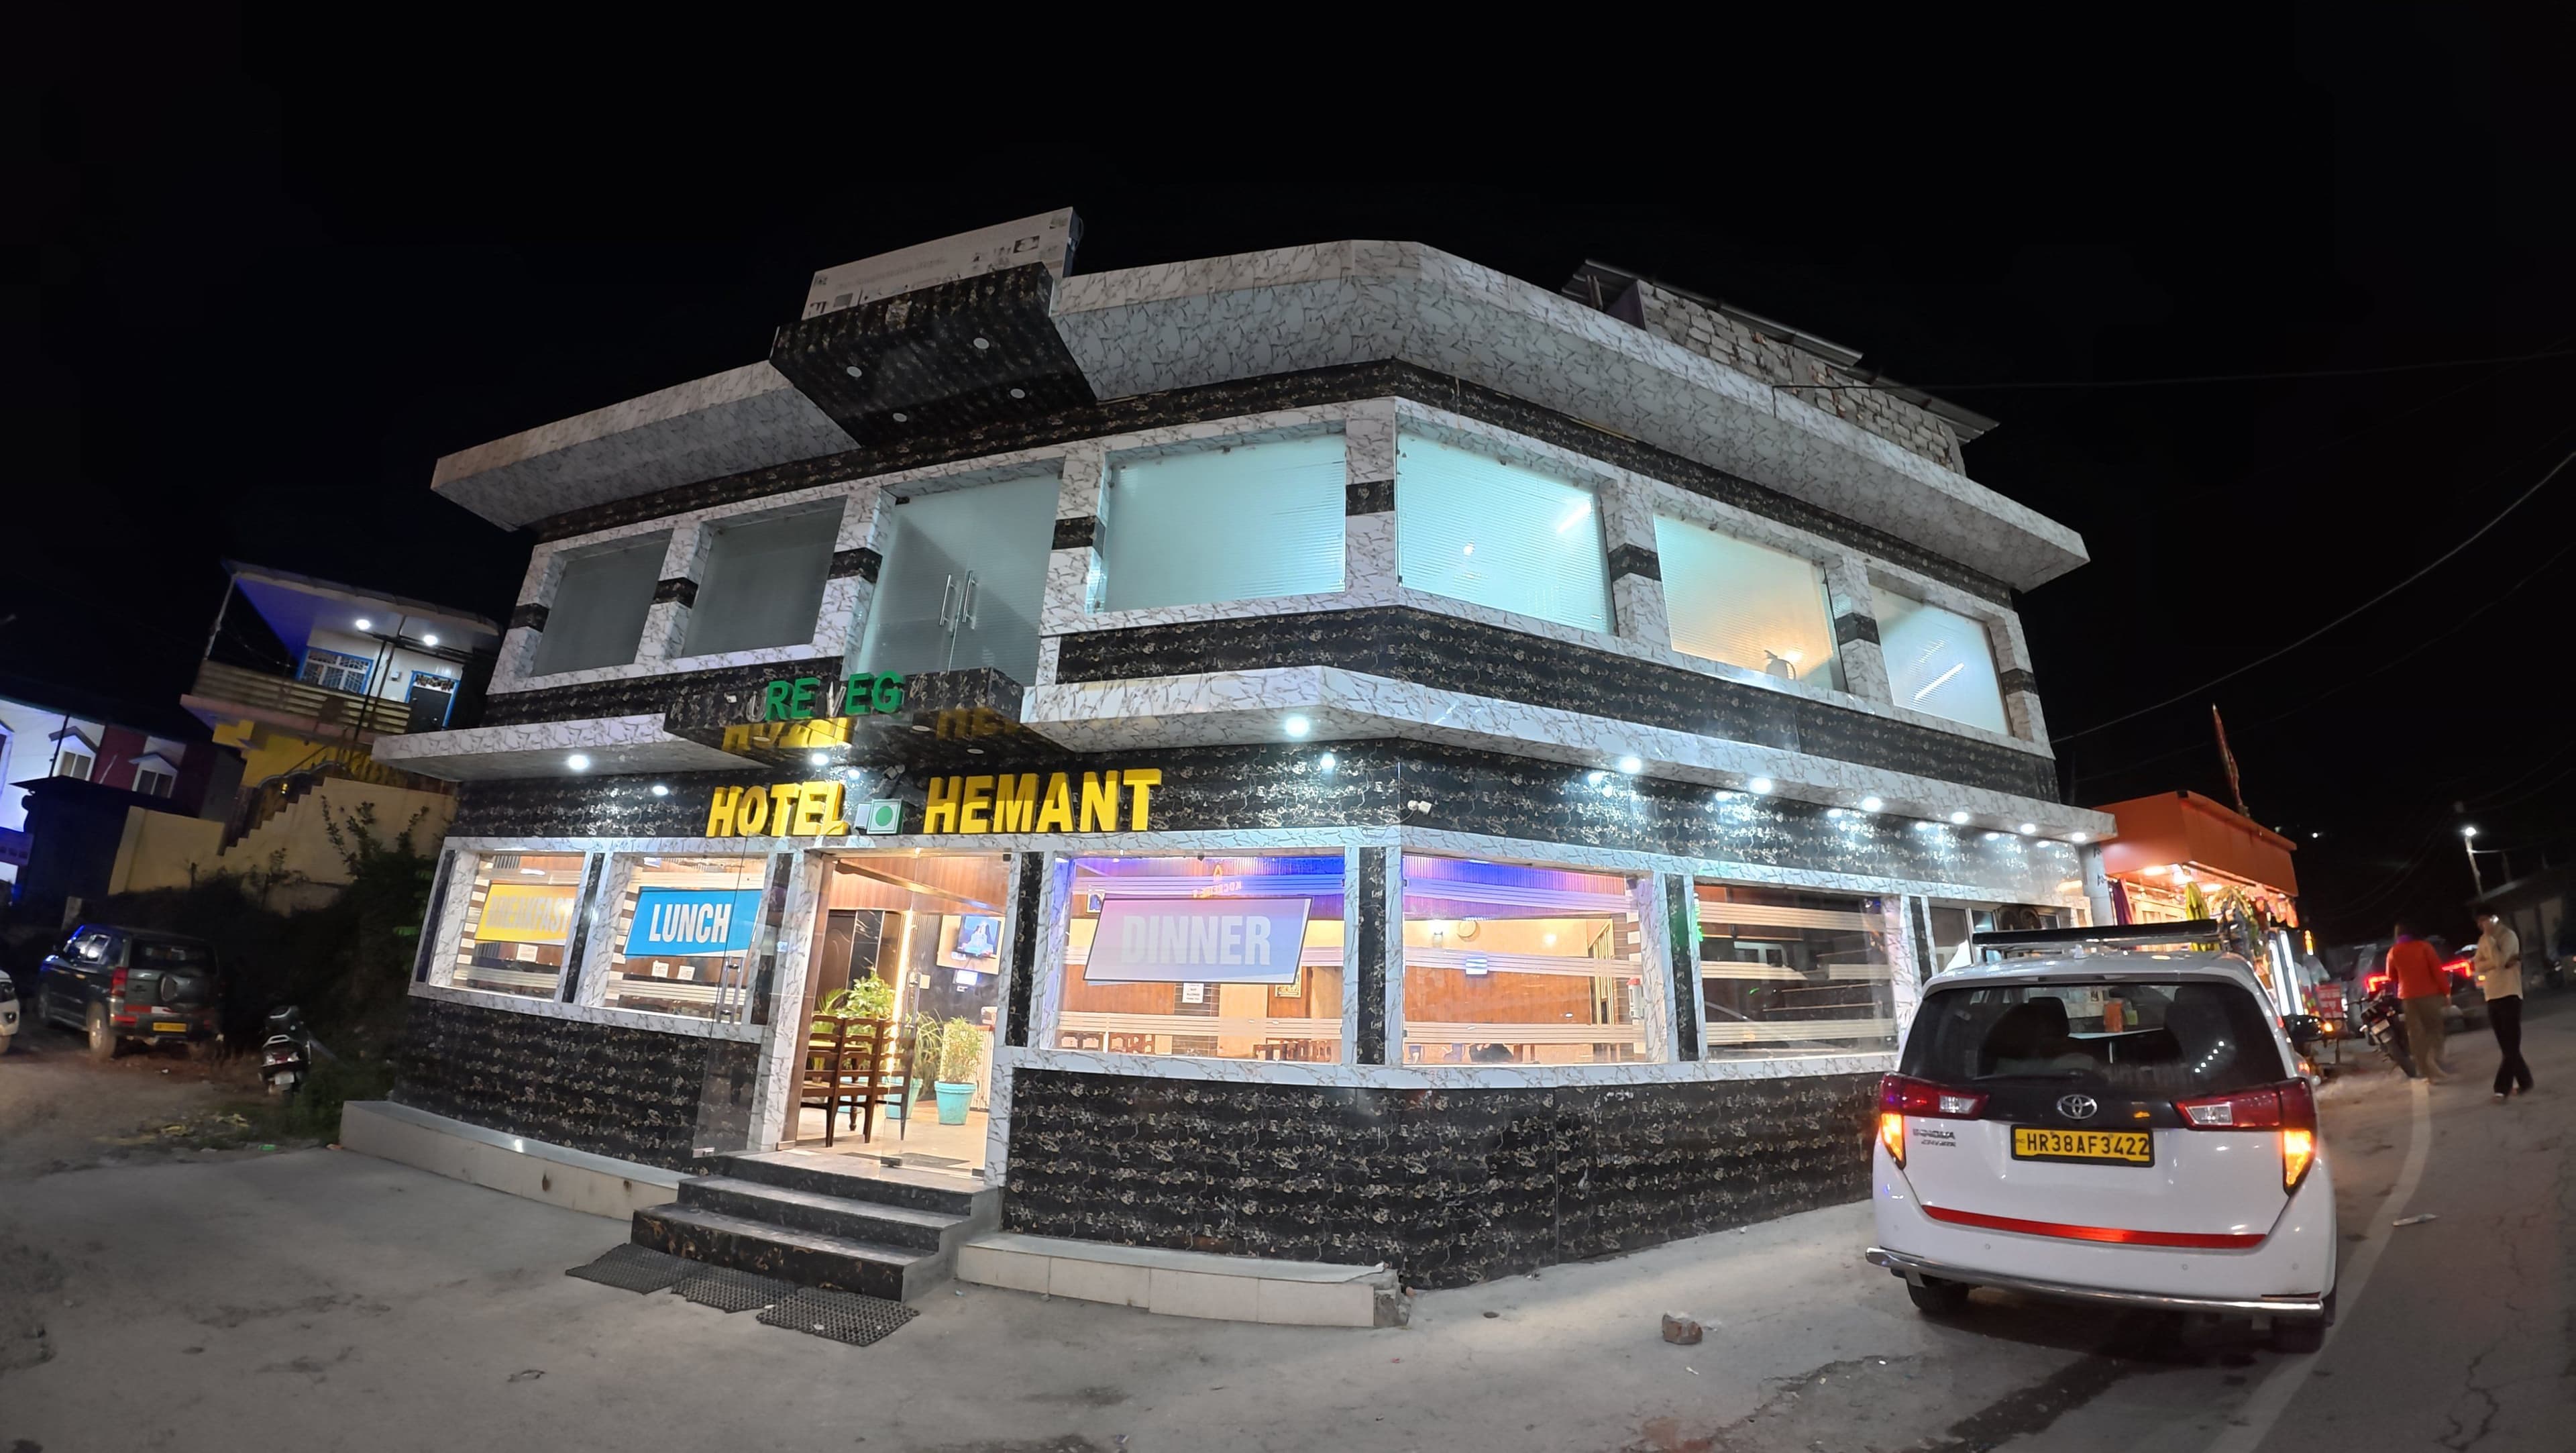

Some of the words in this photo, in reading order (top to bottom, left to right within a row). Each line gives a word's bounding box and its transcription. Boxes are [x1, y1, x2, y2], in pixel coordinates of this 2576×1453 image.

[706, 781, 848, 837] HOTEL
[923, 769, 1162, 833] HEMANT
[487, 895, 576, 933] BREAKFAST
[649, 903, 731, 943] LUNCH
[1122, 915, 1271, 965] DINNER
[2027, 1133, 2149, 1156] HR38AF3422
